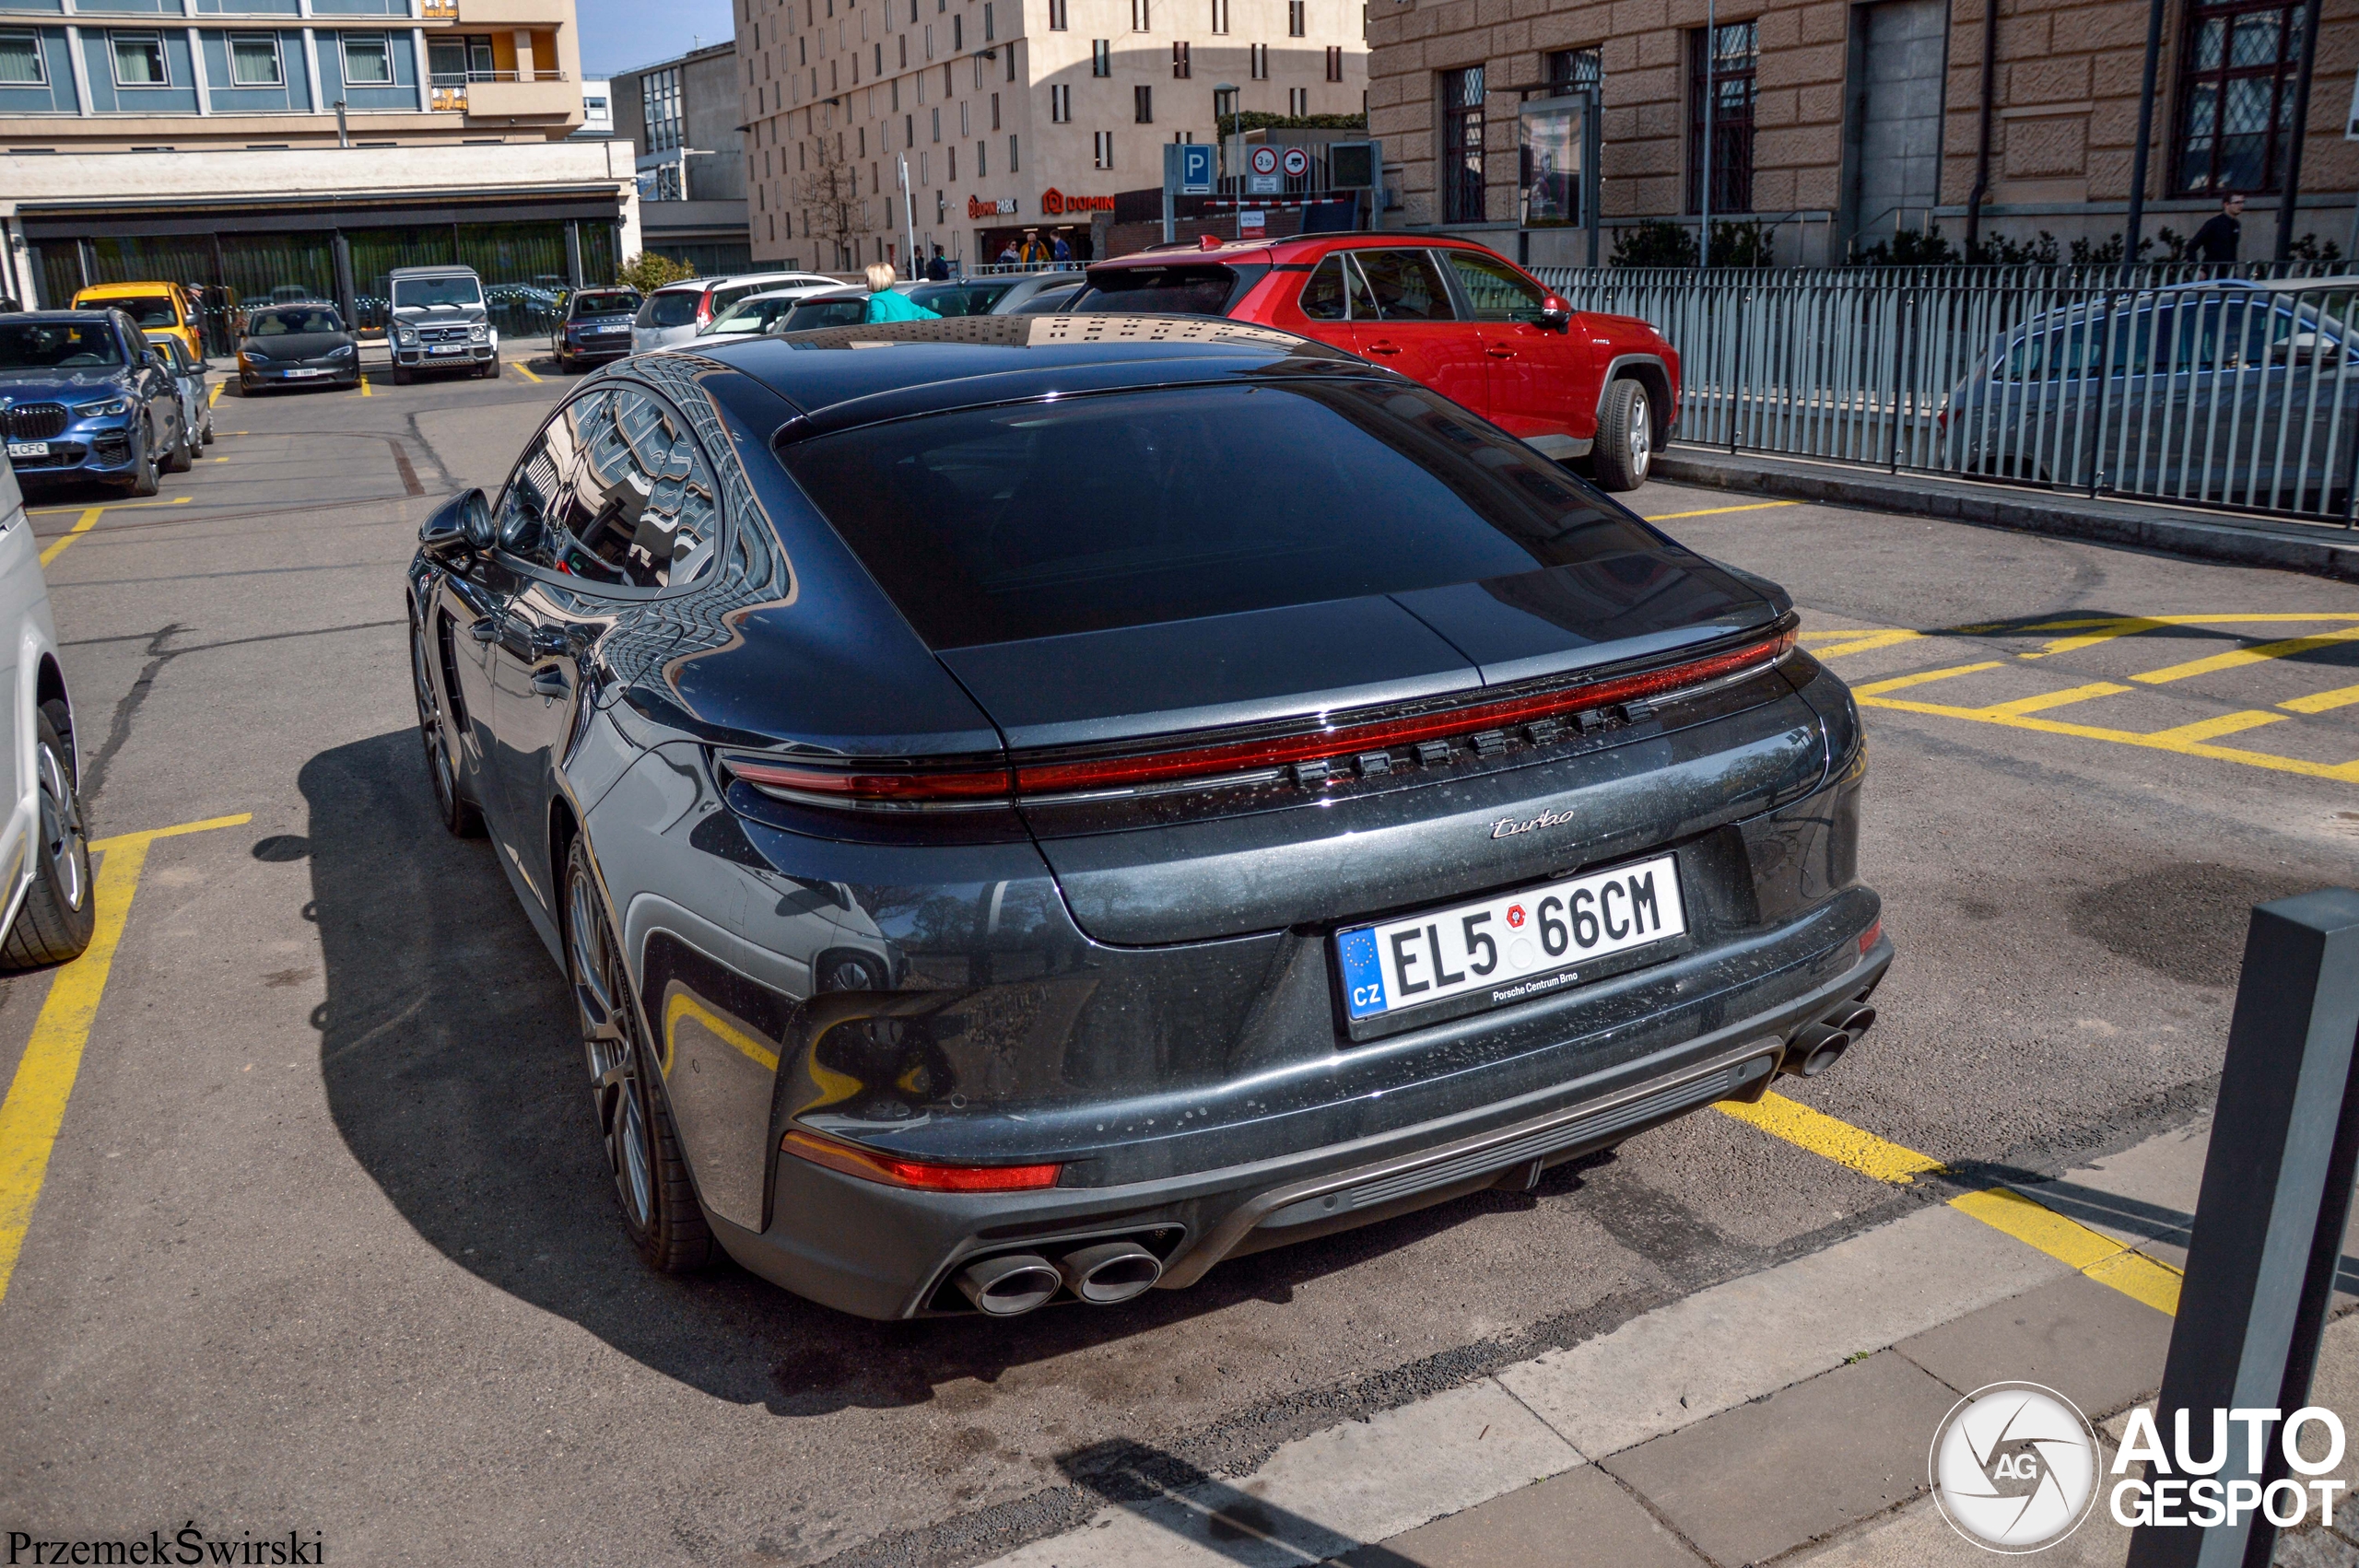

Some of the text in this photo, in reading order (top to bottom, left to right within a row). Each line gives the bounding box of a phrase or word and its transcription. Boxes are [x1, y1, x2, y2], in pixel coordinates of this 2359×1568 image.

[1189, 154, 1204, 178] P
[1066, 195, 1115, 212] DOMIN
[1490, 808, 1575, 839] turbo
[1390, 870, 1661, 997] EL5 66CM
[1354, 983, 1382, 1007] CZ
[1493, 972, 1579, 1002] Porsche Centrum Brno
